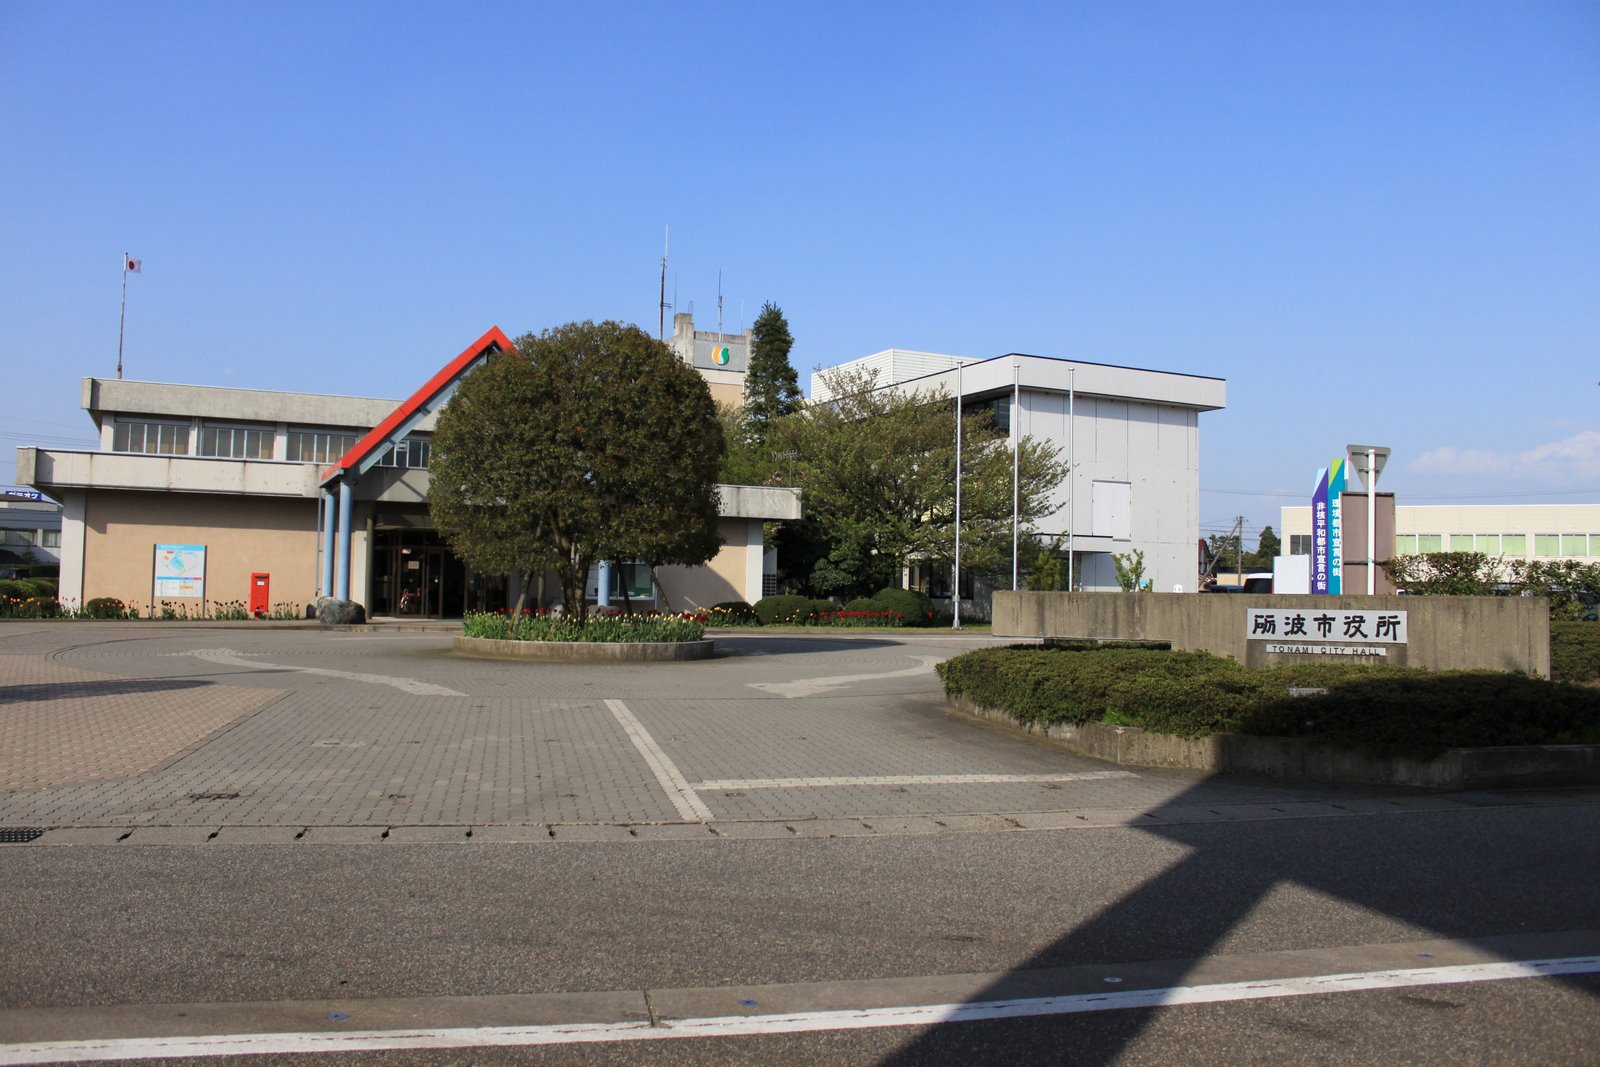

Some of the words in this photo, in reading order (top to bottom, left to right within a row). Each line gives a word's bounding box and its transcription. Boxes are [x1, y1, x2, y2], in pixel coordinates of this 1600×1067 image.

[1316, 502, 1326, 590] 非核平和都市宣言の街
[1252, 613, 1401, 641] 砺波市役所
[1272, 645, 1314, 653] TONAMI
[1320, 646, 1345, 654] CITY
[1352, 648, 1380, 656] HALL
